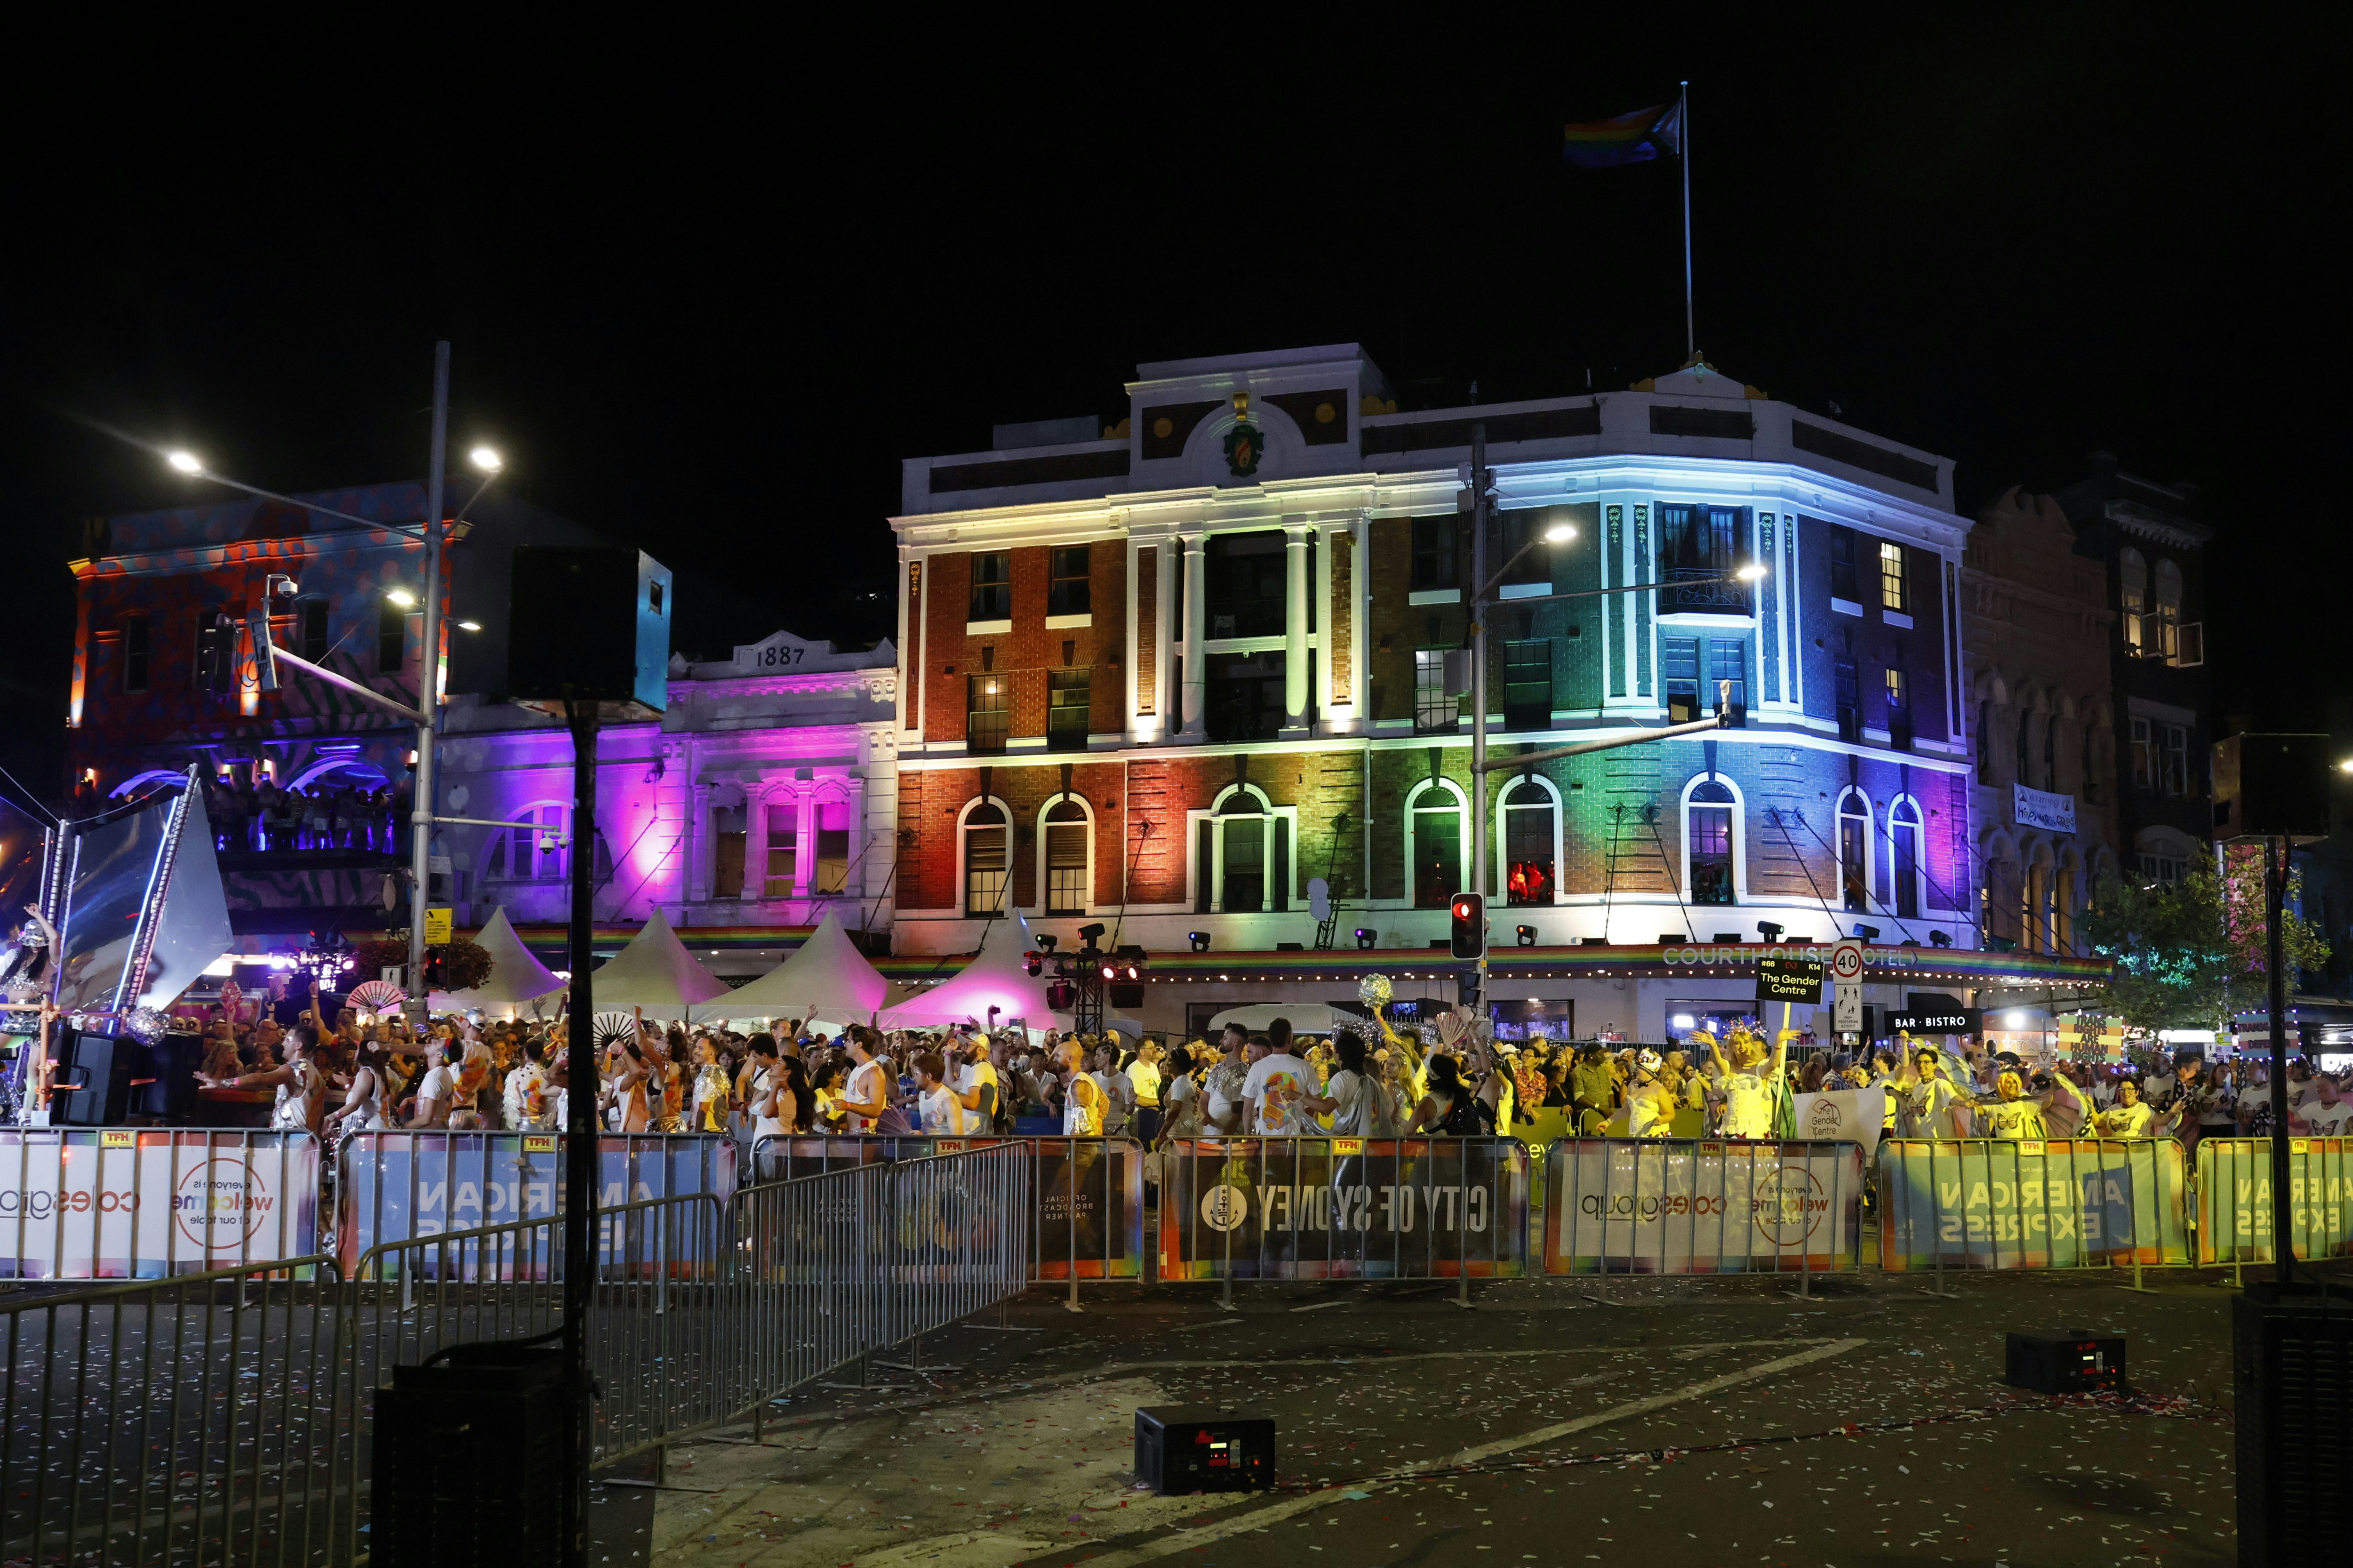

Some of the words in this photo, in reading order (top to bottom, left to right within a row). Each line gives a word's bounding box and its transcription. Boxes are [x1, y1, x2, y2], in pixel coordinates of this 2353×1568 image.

[758, 646, 804, 666] 1887
[1663, 946, 1833, 965] COURTHOUSE
[1862, 948, 1906, 966] OTEL
[1837, 955, 1857, 969] 40
[1761, 973, 1779, 983] The
[1782, 975, 1820, 986] Gender
[1771, 984, 1806, 995] Centre
[1895, 1018, 1916, 1028] BAR
[1926, 1016, 1965, 1027] BISTRO
[2075, 1016, 2106, 1026] TRANS
[2074, 1024, 2107, 1035] RIGHTS
[2080, 1033, 2099, 1044] ARE
[2070, 1042, 2108, 1054] HUMAN
[2072, 1051, 2106, 1062] RIGHTS
[1812, 1117, 1838, 1125] Gender
[1813, 1127, 1836, 1135] Centre
[107, 1133, 128, 1142] TFH
[528, 1138, 550, 1146] TFH
[940, 1142, 961, 1150] TFH
[1338, 1141, 1358, 1149] TFH
[1702, 1143, 1720, 1151] TFH
